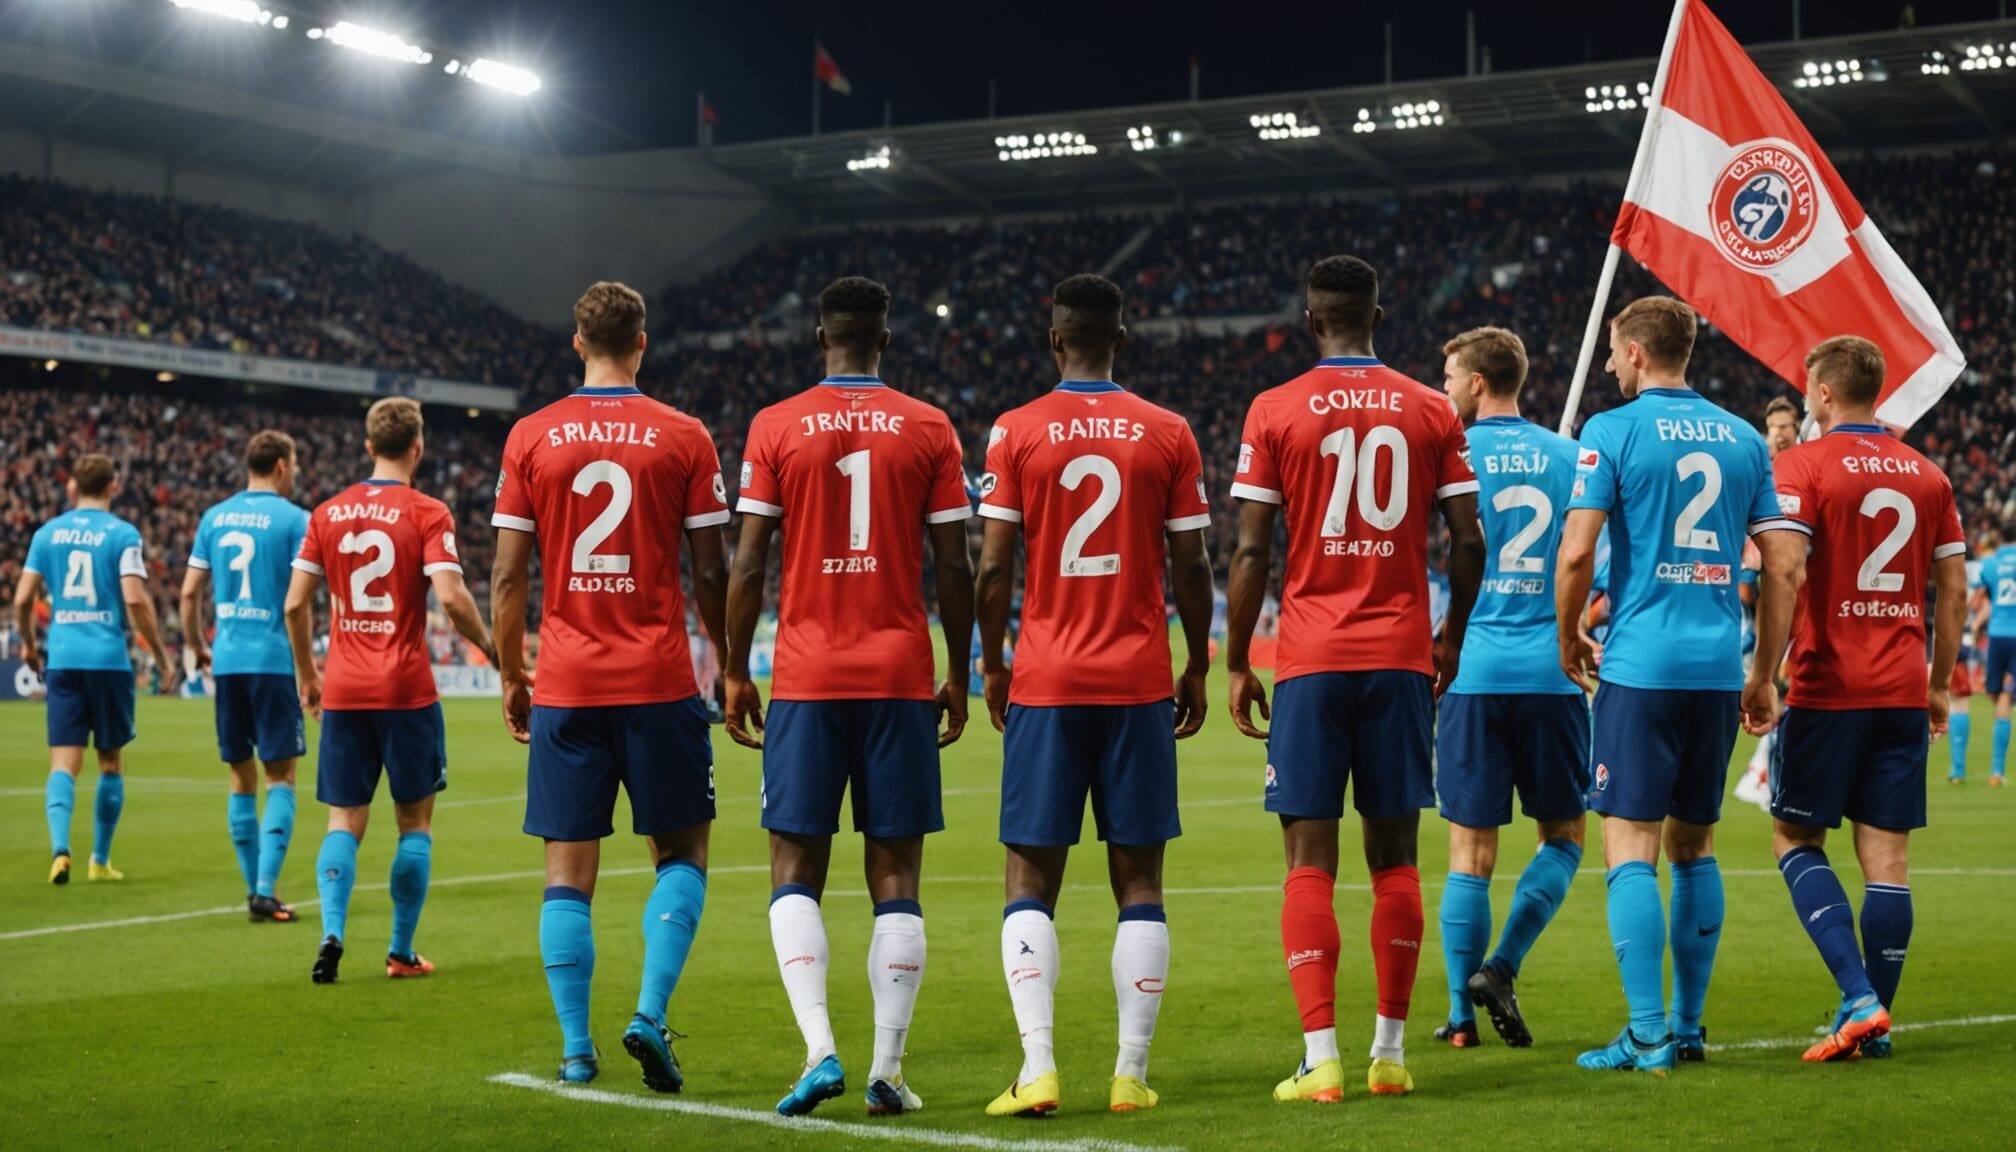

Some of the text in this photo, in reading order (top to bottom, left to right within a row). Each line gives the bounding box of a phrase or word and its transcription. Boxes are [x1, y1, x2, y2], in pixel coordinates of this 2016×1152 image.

[571, 460, 633, 574] 2
[835, 449, 871, 551] 1
[1059, 454, 1122, 577] 2
[1320, 425, 1409, 538] 10
[1492, 485, 1553, 573] 2
[1674, 451, 1722, 552] 2
[63, 549, 98, 607] 4
[338, 529, 396, 613] 2
[1857, 487, 1917, 592] 2
